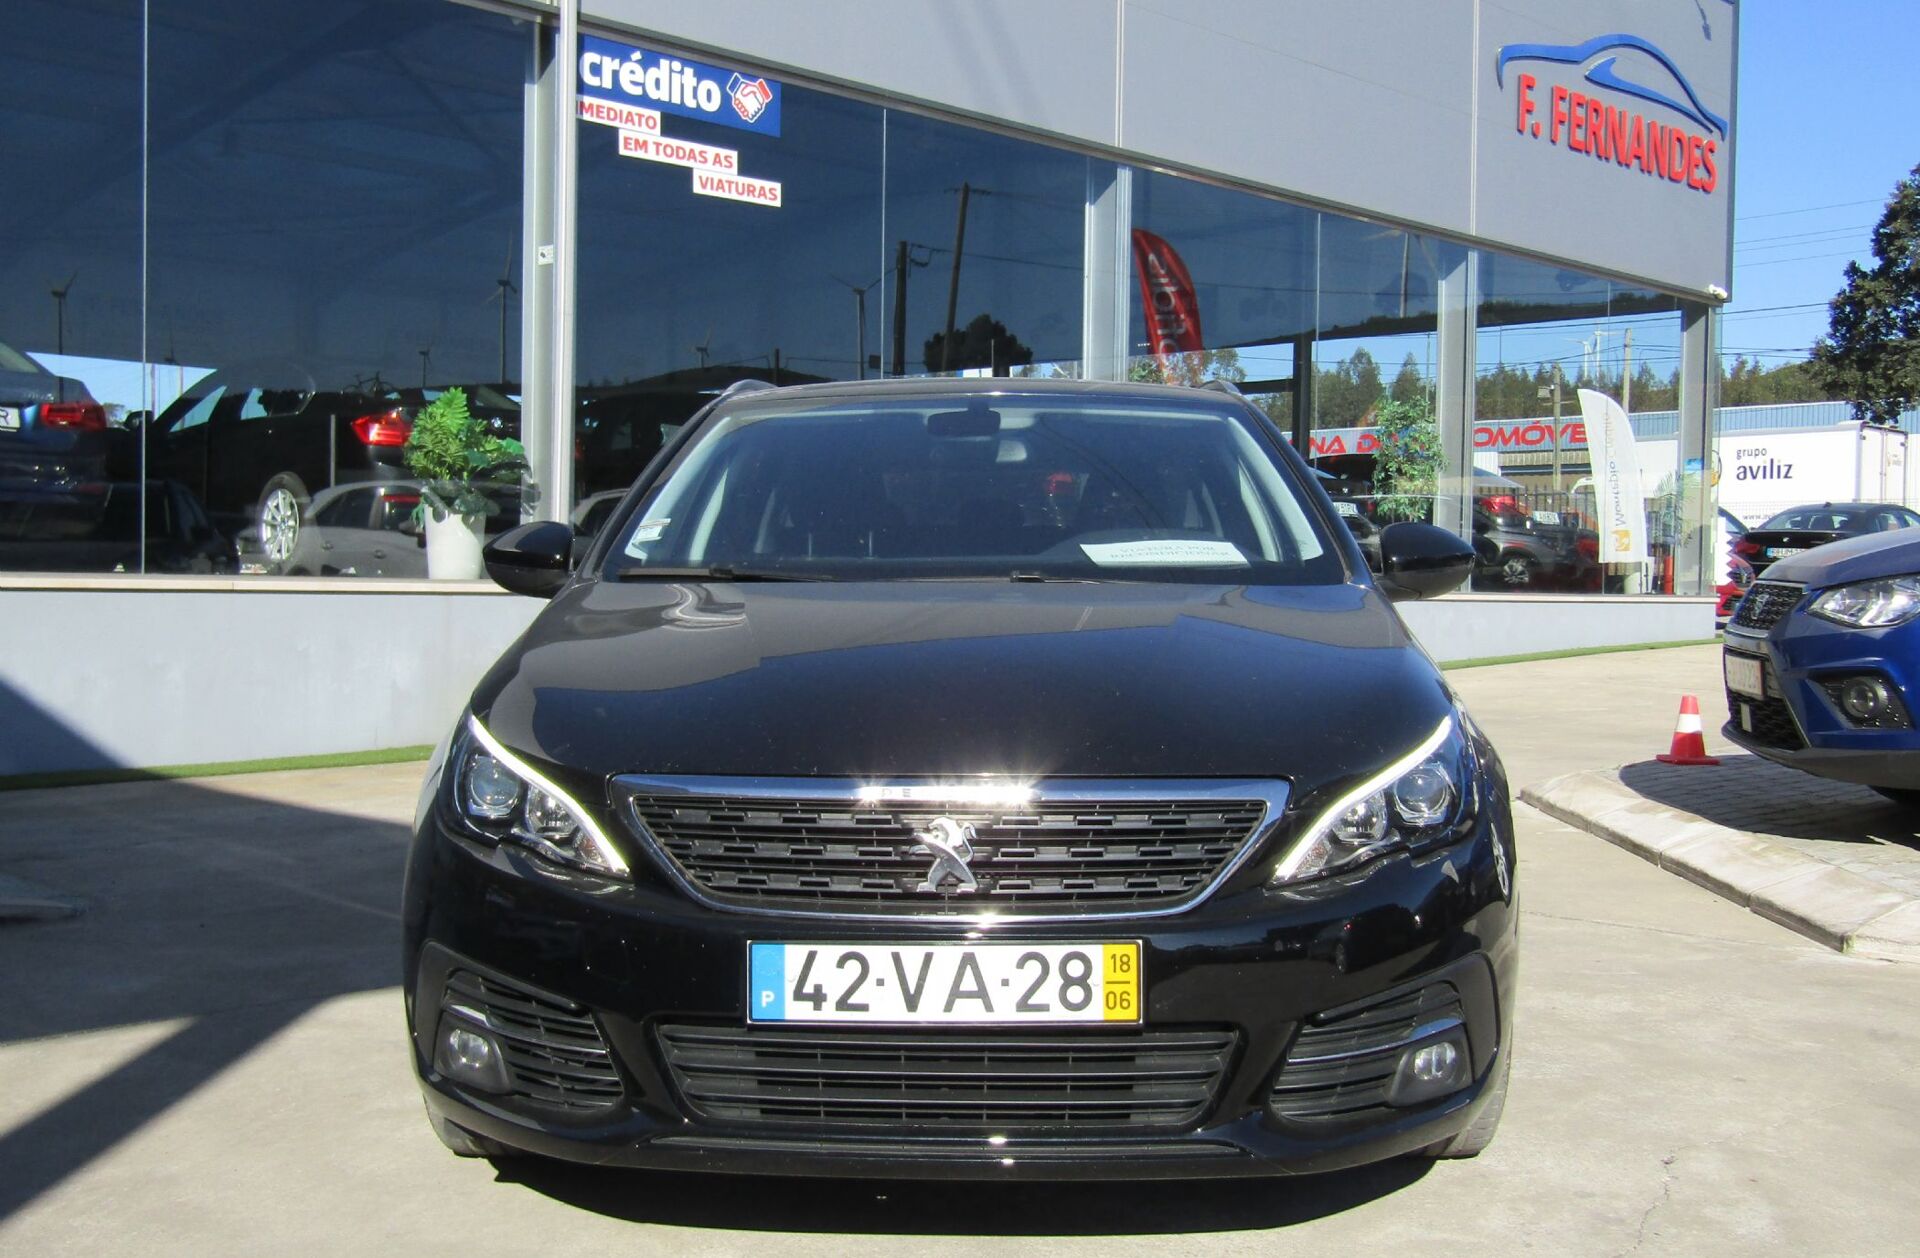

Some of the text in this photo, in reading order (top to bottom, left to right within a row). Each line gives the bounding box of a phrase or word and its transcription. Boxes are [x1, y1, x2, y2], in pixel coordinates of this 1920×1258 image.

[579, 51, 721, 112] crédito
[1517, 73, 1718, 193] F. FERNANDES
[623, 136, 734, 169] EM TODAS AS
[698, 175, 778, 202] VIATURAS
[1736, 447, 1767, 460] grupo
[1736, 458, 1793, 481] aviliz
[1111, 953, 1131, 974] 18
[761, 992, 774, 1007] P
[1105, 991, 1131, 1011] 06
